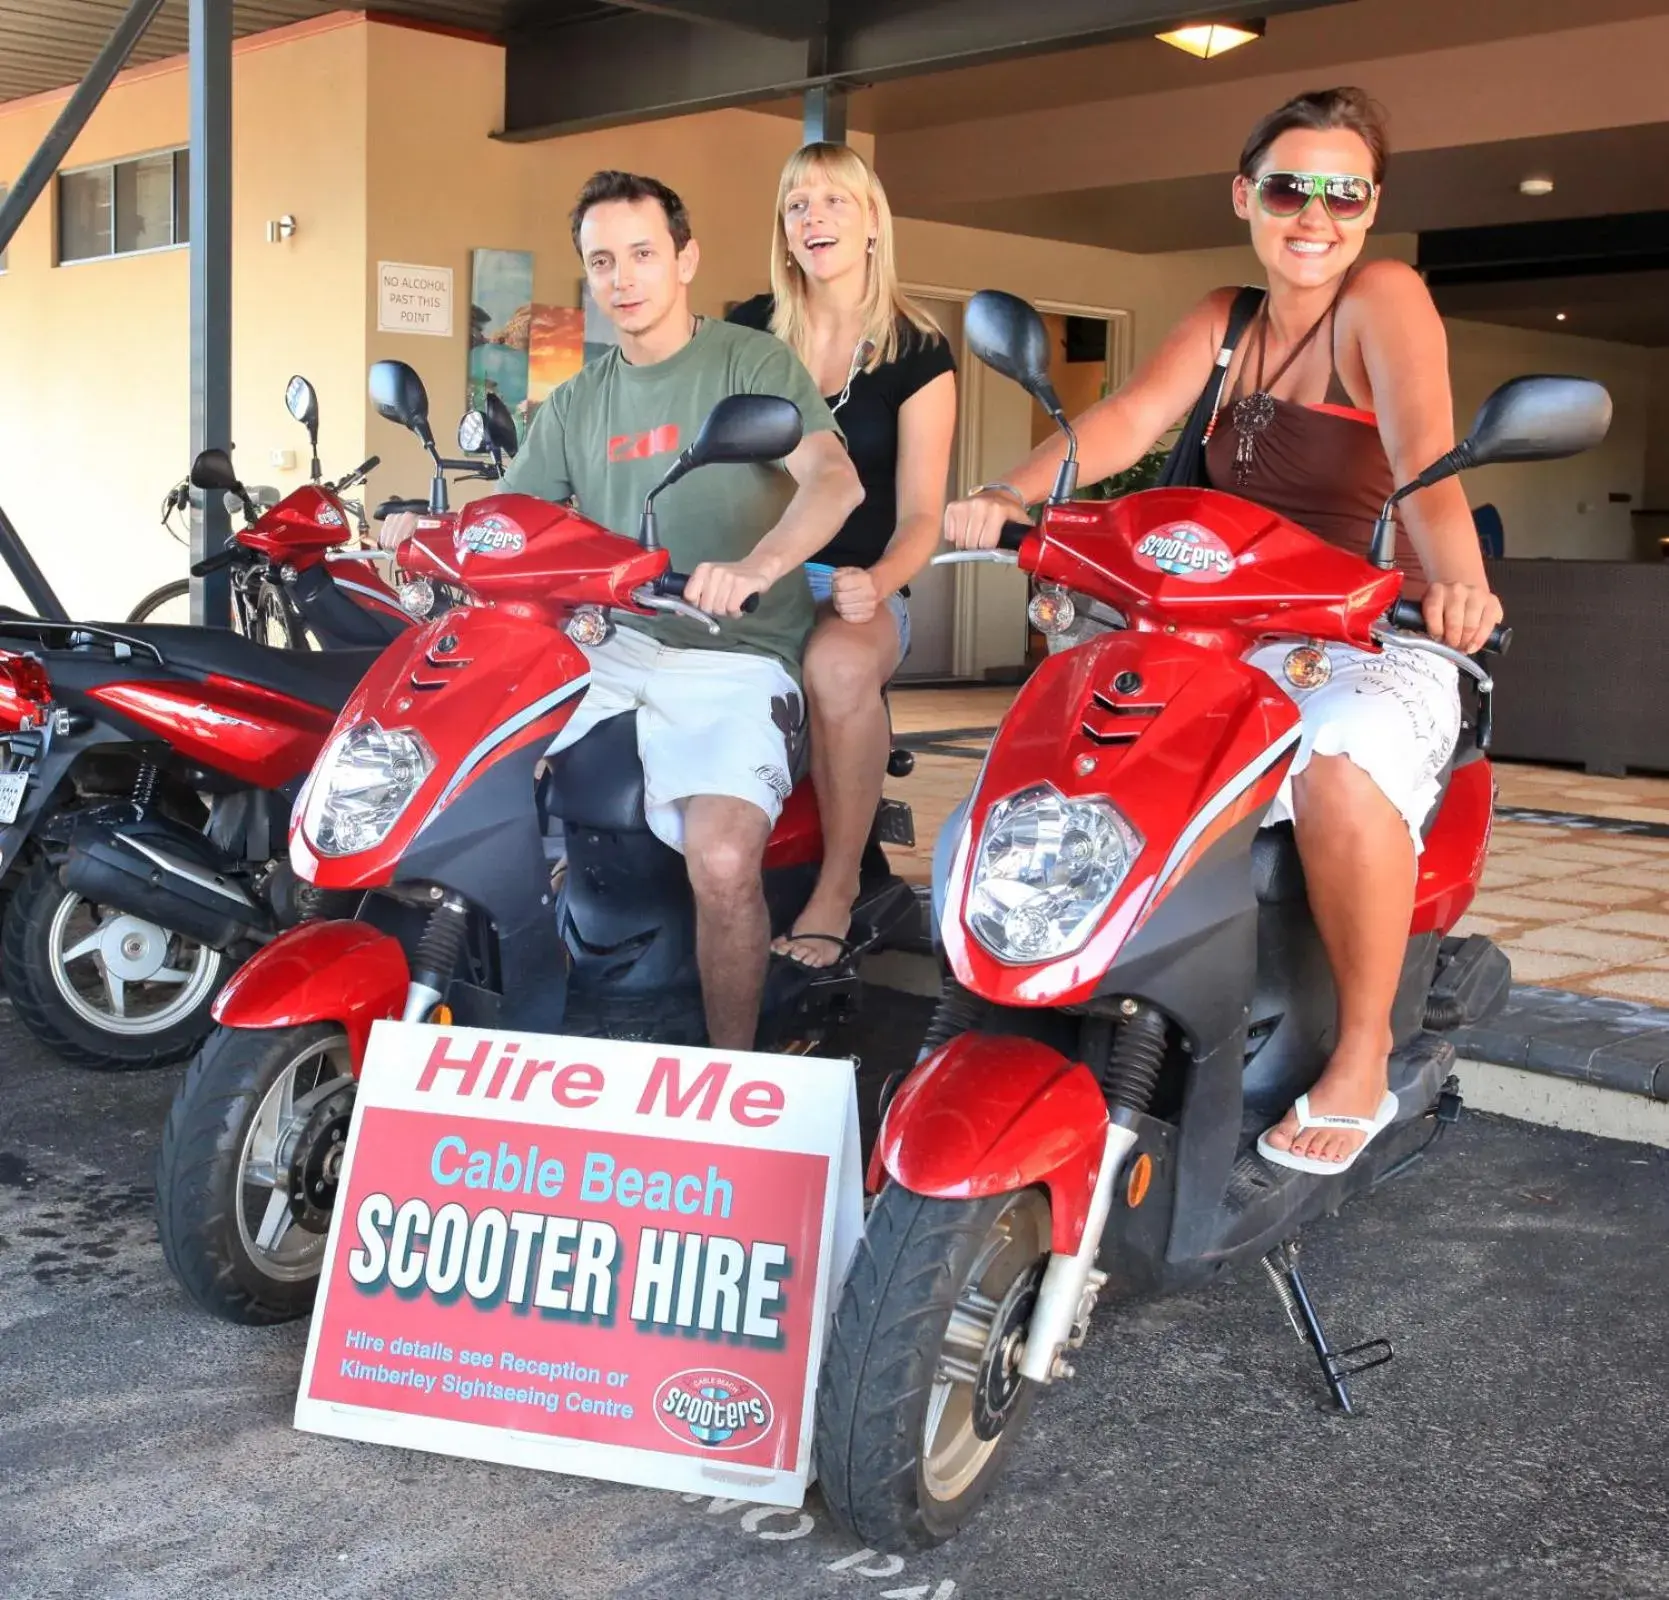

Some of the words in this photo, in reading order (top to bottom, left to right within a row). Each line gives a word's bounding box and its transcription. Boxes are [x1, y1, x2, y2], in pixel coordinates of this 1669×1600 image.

[384, 276, 398, 287] NO
[401, 277, 447, 292] ALCOHOL
[389, 293, 415, 305] PAST
[417, 295, 441, 308] THIS
[400, 311, 432, 323] POINT
[1138, 534, 1230, 573] scooters
[415, 1036, 605, 1108] Hire
[637, 1057, 786, 1128] Me
[431, 1135, 565, 1197] Cable
[581, 1153, 733, 1218] Beach
[348, 1193, 618, 1316] SCOOTER
[630, 1227, 784, 1338] HIRE
[345, 1329, 384, 1353] Hire
[390, 1335, 453, 1362] details
[459, 1346, 494, 1368] see
[500, 1352, 601, 1388] Reception
[606, 1369, 629, 1388] or
[340, 1358, 437, 1394] Kimberley
[441, 1372, 559, 1413] Sightseeing
[566, 1390, 634, 1419] Centre
[693, 1377, 716, 1389] CABLE
[717, 1378, 739, 1393] BEACH
[662, 1387, 766, 1429] scooters
